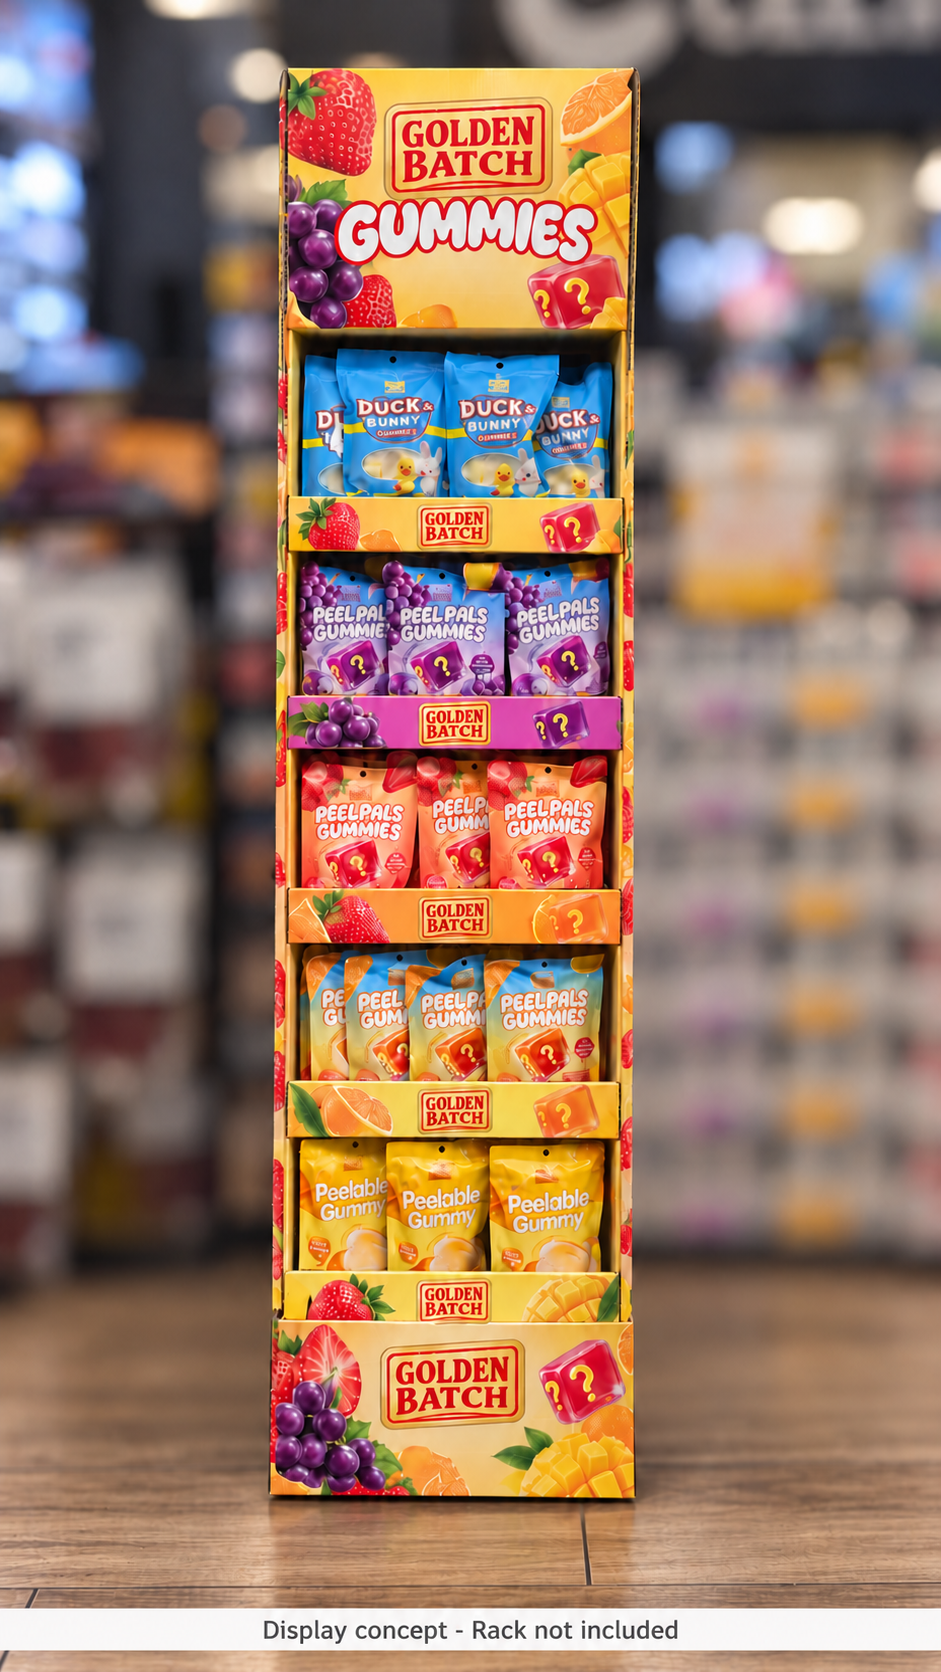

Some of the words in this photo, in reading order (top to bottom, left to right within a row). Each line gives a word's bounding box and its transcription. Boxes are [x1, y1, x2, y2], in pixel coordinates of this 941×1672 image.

[402, 116, 534, 148] GOLDEN
[403, 149, 533, 183] BATCH
[336, 198, 597, 264] GUMMIES
[358, 397, 420, 415] DUCK
[422, 401, 434, 411] &
[459, 399, 523, 419] DUCK
[524, 404, 537, 414] &
[366, 415, 420, 428] BUNNY
[467, 417, 521, 432] BUNNY
[541, 427, 589, 446] BUNNY
[425, 511, 484, 526] GOLDEN
[425, 527, 484, 541] BATCH
[401, 624, 486, 642] GUMMIES
[519, 615, 600, 644] GUMMIES
[426, 709, 484, 724] GOLDEN
[426, 725, 483, 740] BATCH
[317, 822, 402, 841] GUMMIES
[507, 818, 592, 838] GUMMIES
[426, 903, 484, 918] GOLDEN
[426, 919, 484, 933] BATCH
[503, 1008, 588, 1030] GUMMIES
[426, 1095, 484, 1110] GOLDEN
[426, 1111, 484, 1126] BATCH
[315, 1177, 388, 1202] Peelable
[402, 1185, 480, 1210] Peelable
[321, 1199, 387, 1221] Gummy
[508, 1189, 590, 1214] Peelable
[408, 1208, 476, 1229] Gummy
[513, 1211, 584, 1234] Gummy
[425, 1286, 483, 1301] GOLDEN
[425, 1302, 483, 1317] BATCH
[396, 1356, 509, 1385] GOLDEN
[396, 1386, 508, 1415] BATCH
